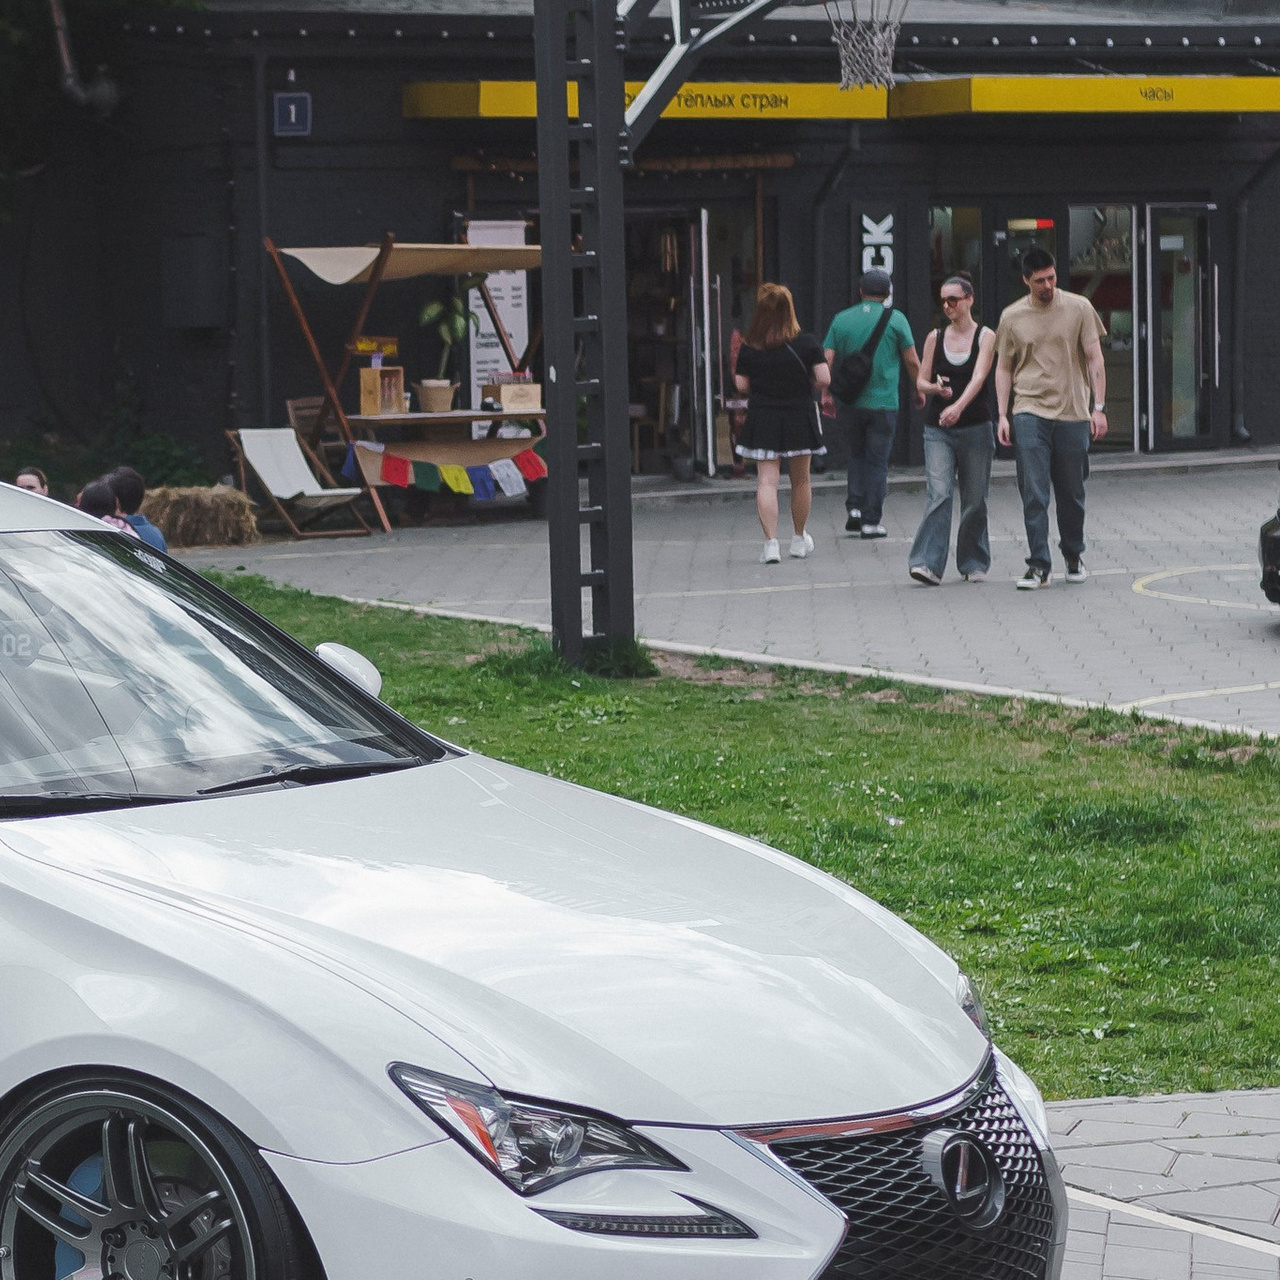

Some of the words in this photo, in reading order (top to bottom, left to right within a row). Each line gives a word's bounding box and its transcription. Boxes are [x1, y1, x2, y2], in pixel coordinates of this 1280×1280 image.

[675, 89, 735, 109] тёплых
[740, 93, 789, 112] стран
[1138, 87, 1174, 101] часы
[2, 633, 31, 657] 02
